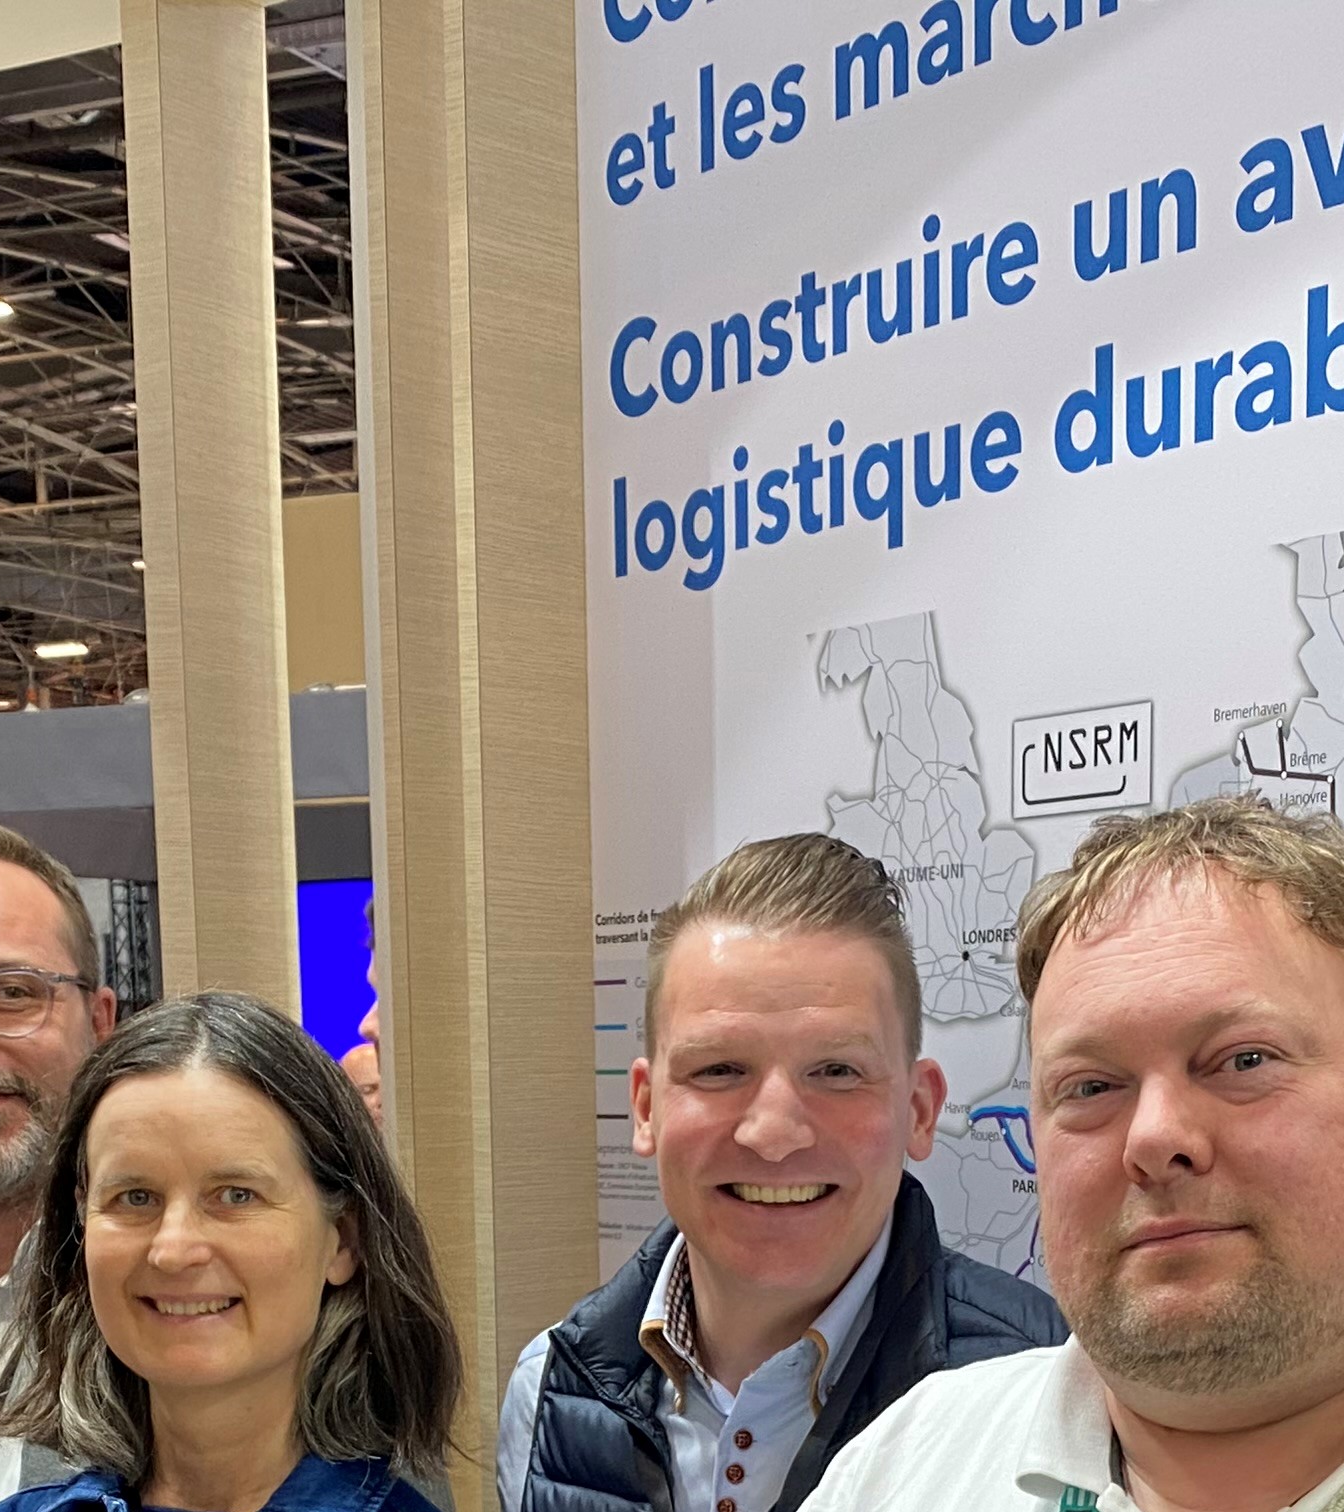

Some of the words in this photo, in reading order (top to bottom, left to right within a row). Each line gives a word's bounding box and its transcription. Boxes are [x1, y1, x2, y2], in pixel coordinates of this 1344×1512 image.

[605, 97, 678, 206] et
[698, 62, 807, 175] les
[609, 214, 1040, 419] Construire
[1073, 166, 1199, 282] un
[612, 410, 1023, 592] logistique
[1213, 702, 1287, 722] Bremerhaven
[1043, 720, 1139, 774] NSRM
[1290, 751, 1328, 767] Brême
[1280, 791, 1328, 806] Hanovre
[888, 863, 964, 883] YAUME-UNI
[595, 911, 636, 926] Corridors
[637, 910, 649, 923] de
[596, 932, 639, 944] traversant
[641, 929, 649, 942] la
[962, 928, 1017, 945] LONDRES
[1012, 1180, 1037, 1193] PARI
